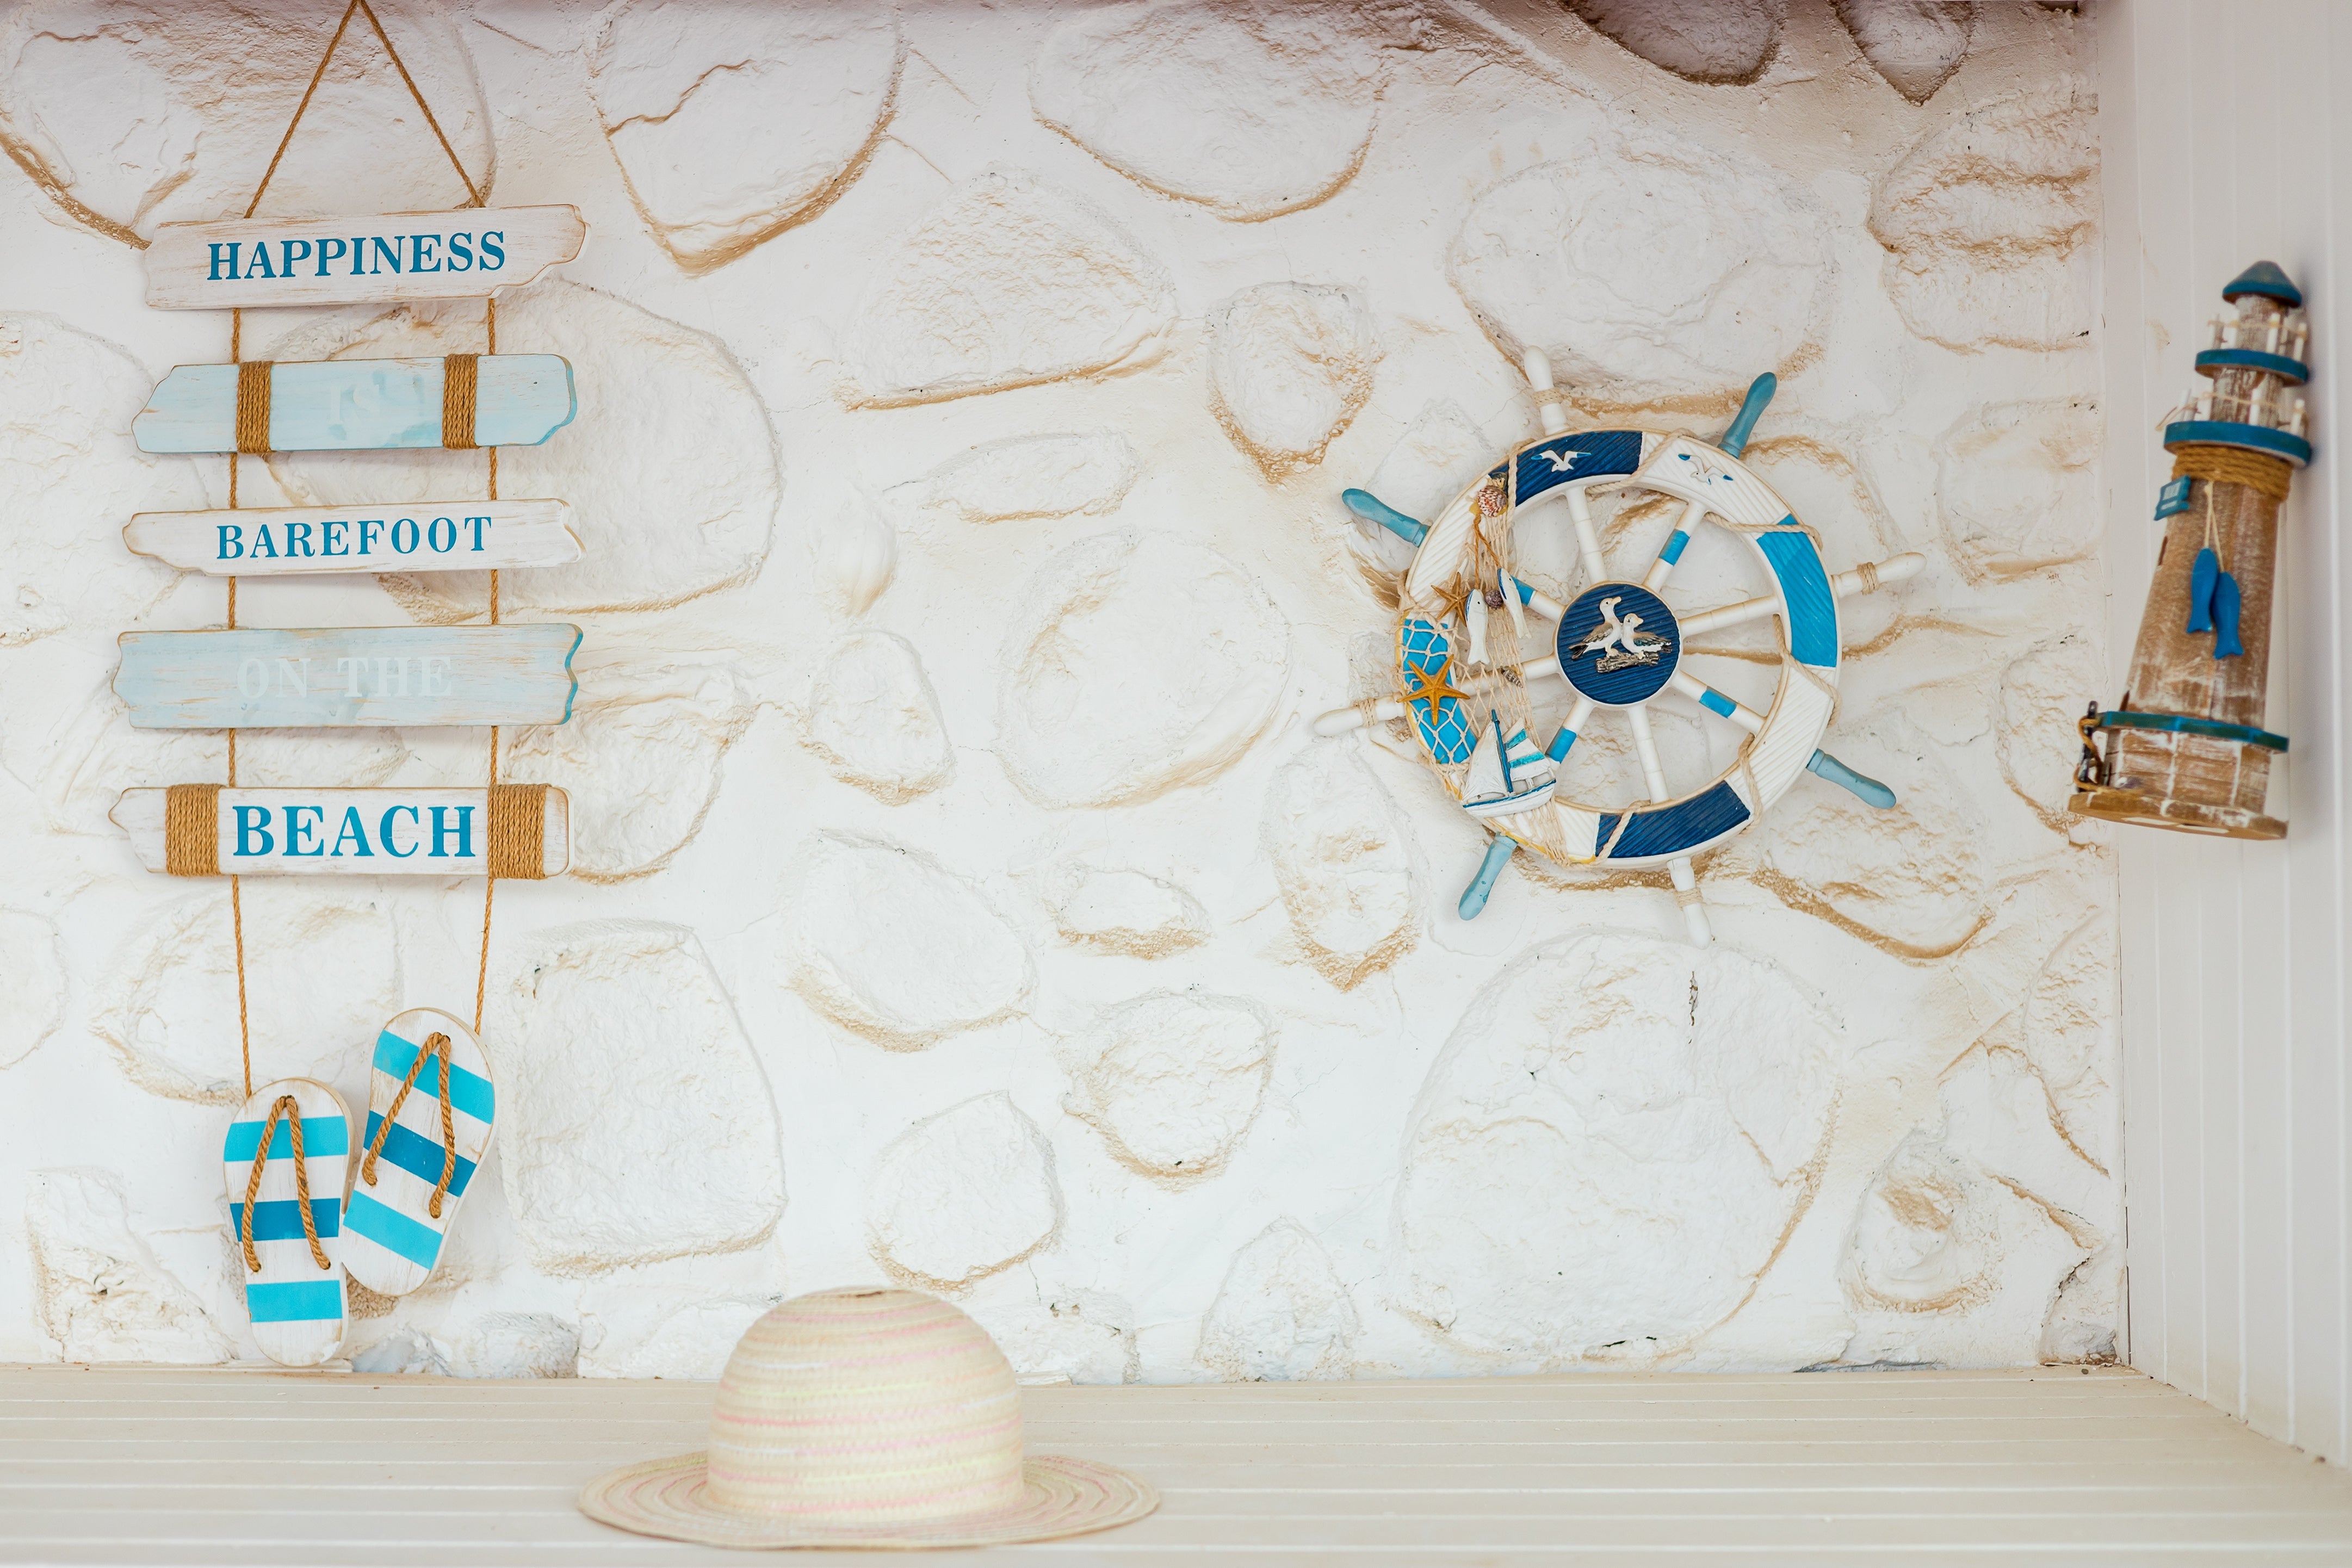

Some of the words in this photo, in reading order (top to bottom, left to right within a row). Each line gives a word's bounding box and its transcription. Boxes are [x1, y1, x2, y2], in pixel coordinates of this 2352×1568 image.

[207, 231, 505, 280] HAPPINESS
[217, 517, 492, 559] BAREFOOT
[237, 658, 311, 698] ON
[337, 656, 453, 697] THE
[232, 805, 475, 858] BEACH
